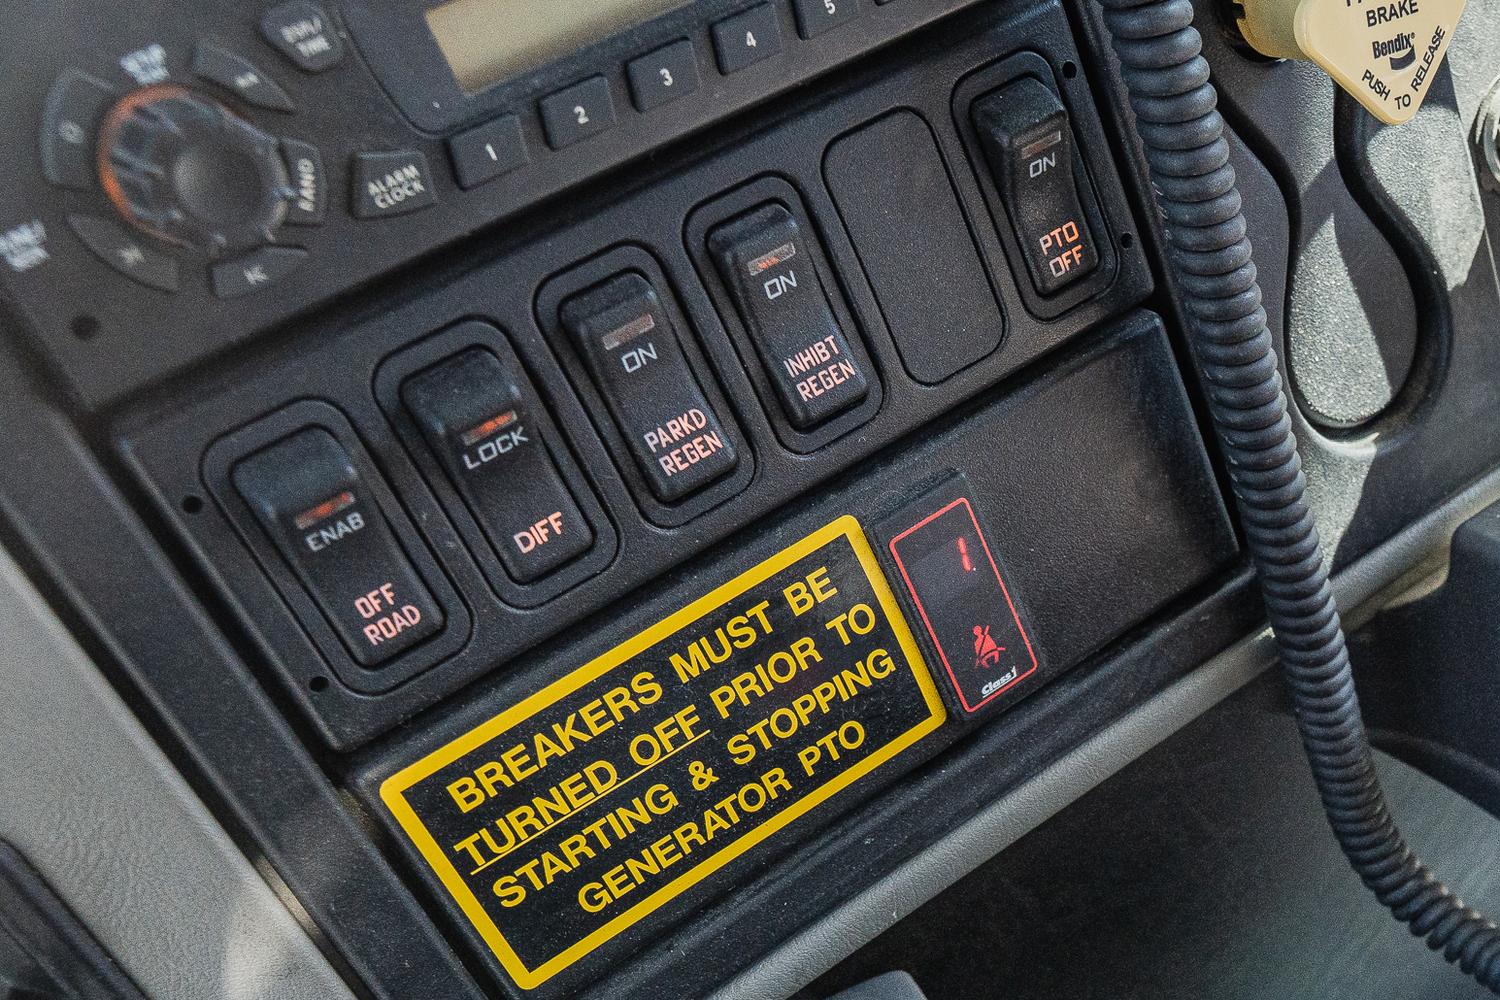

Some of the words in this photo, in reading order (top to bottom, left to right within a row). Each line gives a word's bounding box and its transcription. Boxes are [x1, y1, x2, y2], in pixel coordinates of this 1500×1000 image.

[1366, 0, 1419, 27] BRAKE
[745, 31, 757, 48] 4
[658, 68, 673, 87] 3
[1362, 69, 1390, 101] PUSH
[1395, 94, 1411, 110] TO
[1411, 25, 1446, 92] RELEASE
[573, 105, 589, 124] 2
[485, 143, 498, 161] 1
[1029, 152, 1056, 178] ON
[367, 164, 420, 196] ALARM
[375, 180, 425, 208] CLOCK
[1039, 221, 1080, 256] PTO
[1049, 244, 1083, 278] OFF
[763, 271, 798, 300] ON
[621, 343, 658, 373] ON
[783, 335, 841, 379] INHIBT
[796, 359, 856, 401] REGEN
[462, 426, 529, 469] LOCK
[644, 408, 707, 453] PARKD
[658, 430, 724, 476] REGEN
[306, 512, 365, 551] ENAB
[513, 512, 563, 554] DIFF
[354, 583, 396, 619] OFF
[363, 605, 421, 646] ROAD
[446, 670, 663, 814] BREAKERS
[670, 603, 774, 685] MUST
[790, 566, 839, 619] BE
[453, 759, 618, 868] TURNED
[629, 705, 702, 763] OFF
[716, 636, 823, 718] PRIOR
[825, 603, 878, 650] TO
[492, 783, 679, 908] STARTING
[690, 761, 719, 792] &
[733, 648, 896, 763] STOPPING
[577, 767, 792, 914] GENERATOR
[798, 720, 865, 777] PTO
